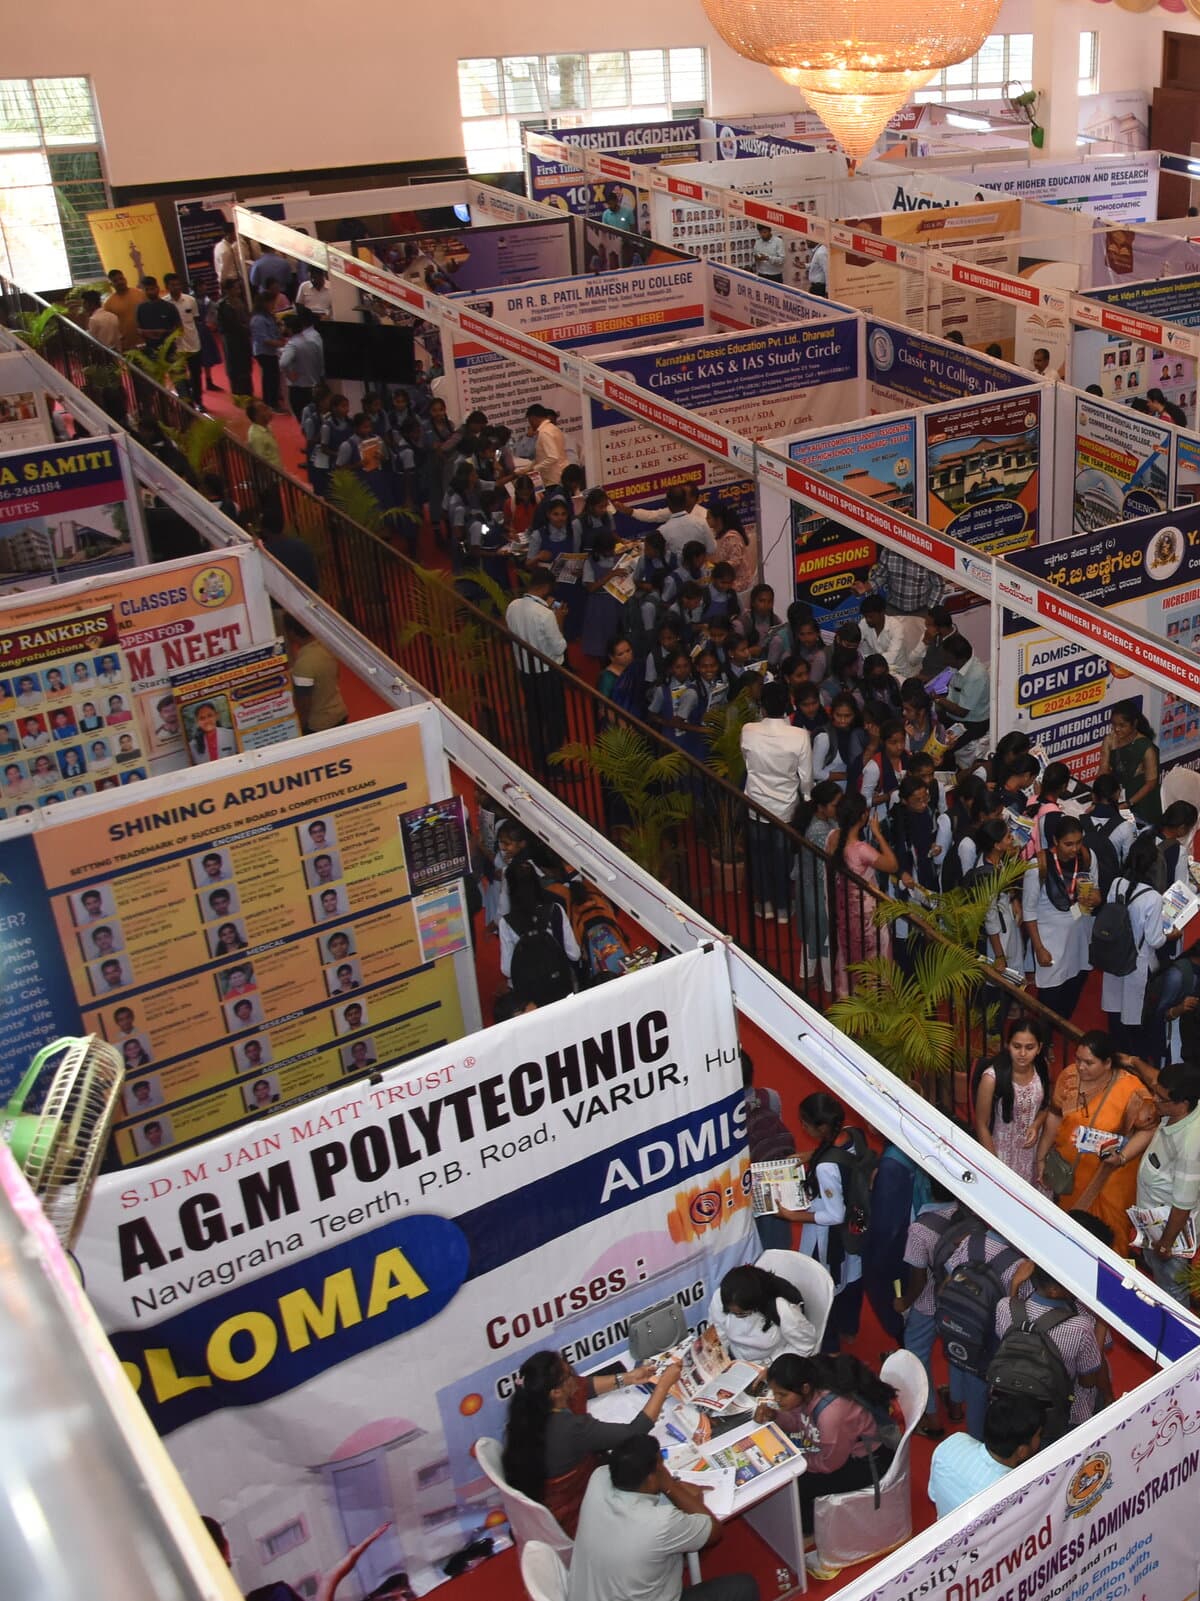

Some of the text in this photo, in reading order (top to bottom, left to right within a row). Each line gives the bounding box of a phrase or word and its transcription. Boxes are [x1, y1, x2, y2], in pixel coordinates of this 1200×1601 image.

[624, 126, 696, 145] ACADEMYS
[1016, 168, 1149, 190] HIGHER EDUCATION AND RESEARCH
[1093, 200, 1141, 212] HOMOEOPATHIC
[507, 272, 693, 312] DR PATIL MAHESH PU COLLEGE
[552, 322, 593, 340] FUTURE
[596, 316, 634, 332] BEGINS
[656, 328, 835, 368] Karnataka Classic Education Dharwad
[649, 342, 841, 388] Classic KAS IAS Study Circle
[899, 350, 927, 370] Classic
[930, 362, 943, 376] PU
[24, 450, 112, 481] SAMITI
[818, 487, 933, 552] KALUTI SPORTS SCHOOL CHANDARGI
[798, 546, 869, 575] ADMISSIONS
[120, 587, 188, 617] CLASSES
[812, 575, 853, 595] OPEN FOR
[19, 617, 109, 648] RANKERS
[161, 622, 242, 671] NEET
[1058, 607, 1091, 630] ANNIGERI
[1103, 627, 1133, 652] SCIENCE
[1142, 647, 1187, 678] COMMERCE
[1020, 659, 1108, 698] OPEN FOR
[1043, 686, 1102, 713] 2024-2025
[108, 758, 354, 842] SHINING ARJUNITES
[113, 840, 174, 866] TRADEMARK
[190, 823, 232, 844] SUCCESS
[245, 808, 279, 828] BOARD
[288, 788, 343, 815] COMPETITIVE
[345, 779, 377, 798] EXAMS
[212, 824, 274, 848] ENGINEERING
[245, 938, 286, 957] MEDICAL
[117, 1010, 670, 1282] A.G.M POLYTECHNIC
[120, 1065, 456, 1210] S.D.M JAIN MATT TRUST
[600, 1101, 749, 1204] ADMIS
[130, 1062, 690, 1318] Navagraha Teerth, P.B. Road, VARUR,
[486, 1265, 627, 1350] Courses
[1018, 1530, 1085, 1601] BUSINESS
[1088, 1450, 1200, 1549] ADMINISTRATION
[946, 1514, 1053, 1601] Dharwad
[1092, 1534, 1153, 1583] Embedded
[1134, 1560, 1160, 1586] India
